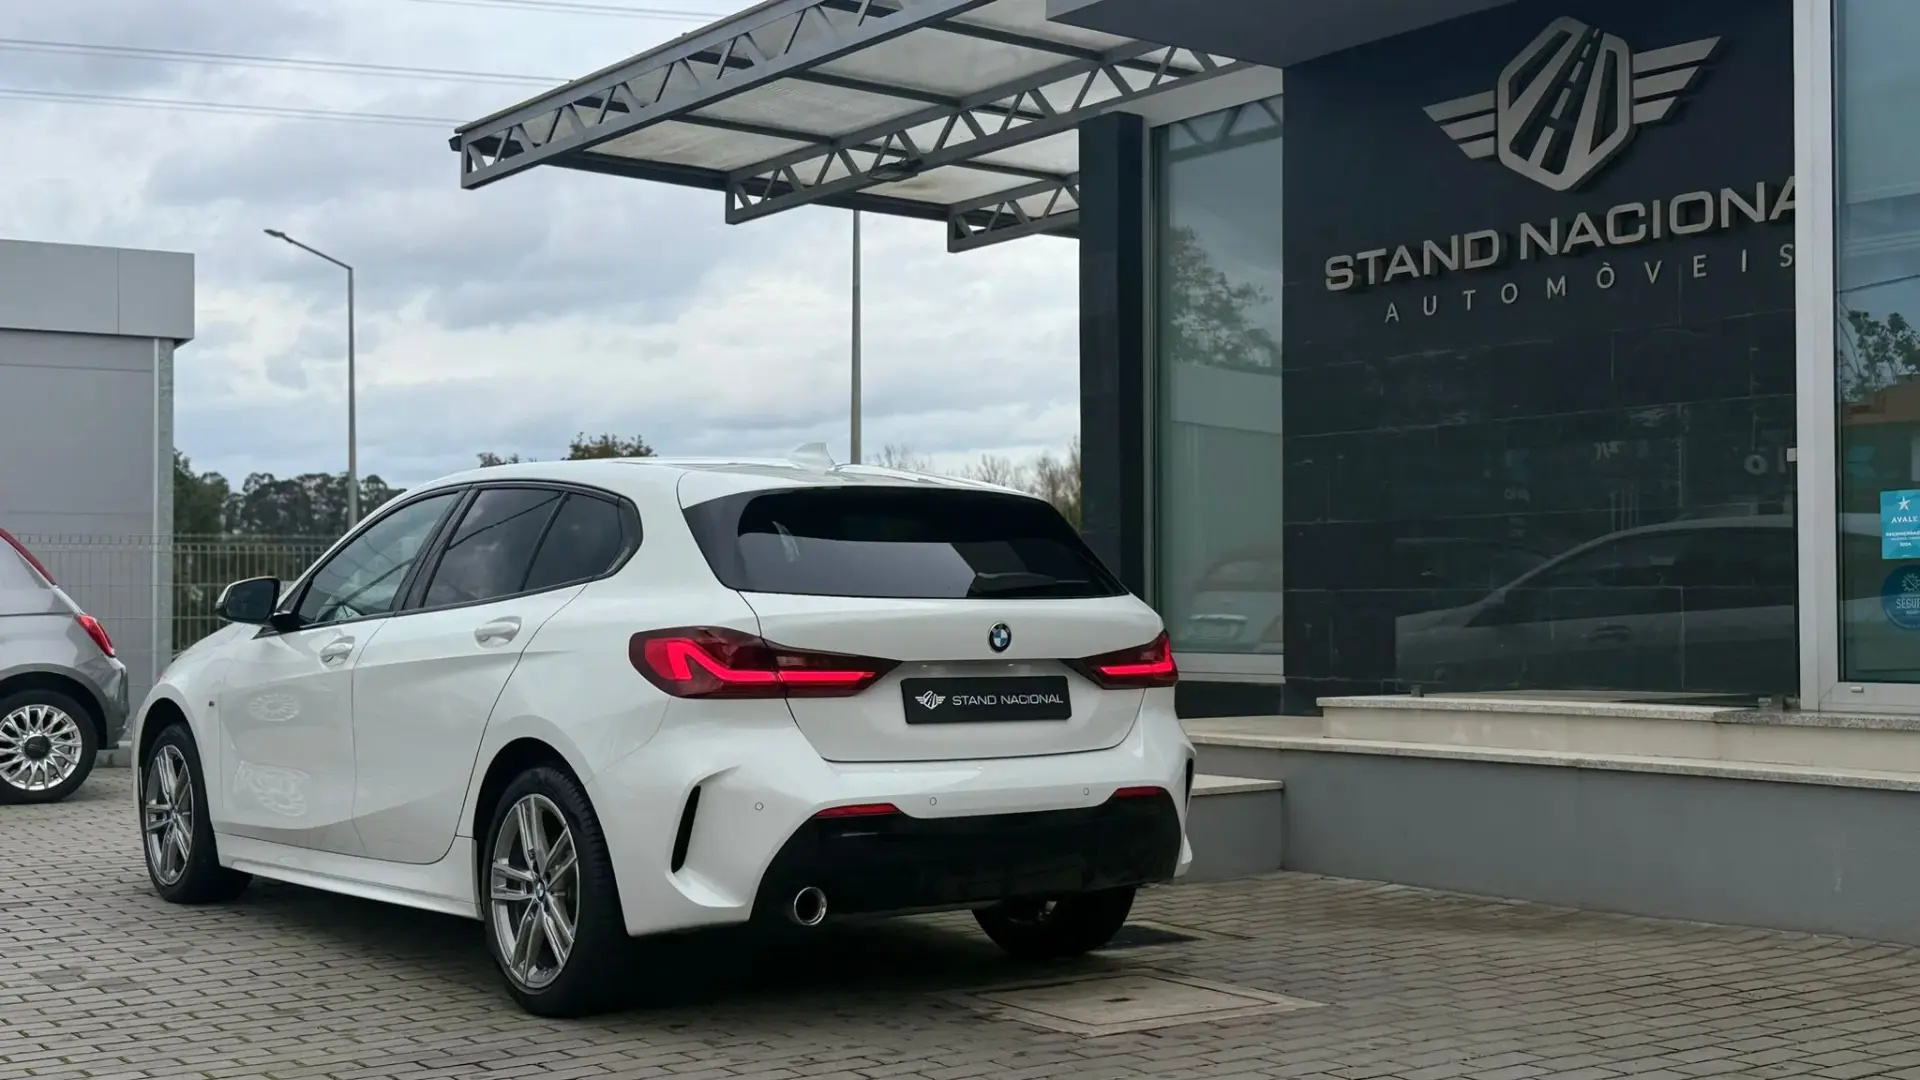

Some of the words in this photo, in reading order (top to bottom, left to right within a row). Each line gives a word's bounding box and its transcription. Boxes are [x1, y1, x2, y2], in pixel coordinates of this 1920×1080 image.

[1325, 229, 1500, 291] STAND
[952, 695, 997, 706] STAND
[1001, 694, 1064, 705] NACIONAL
